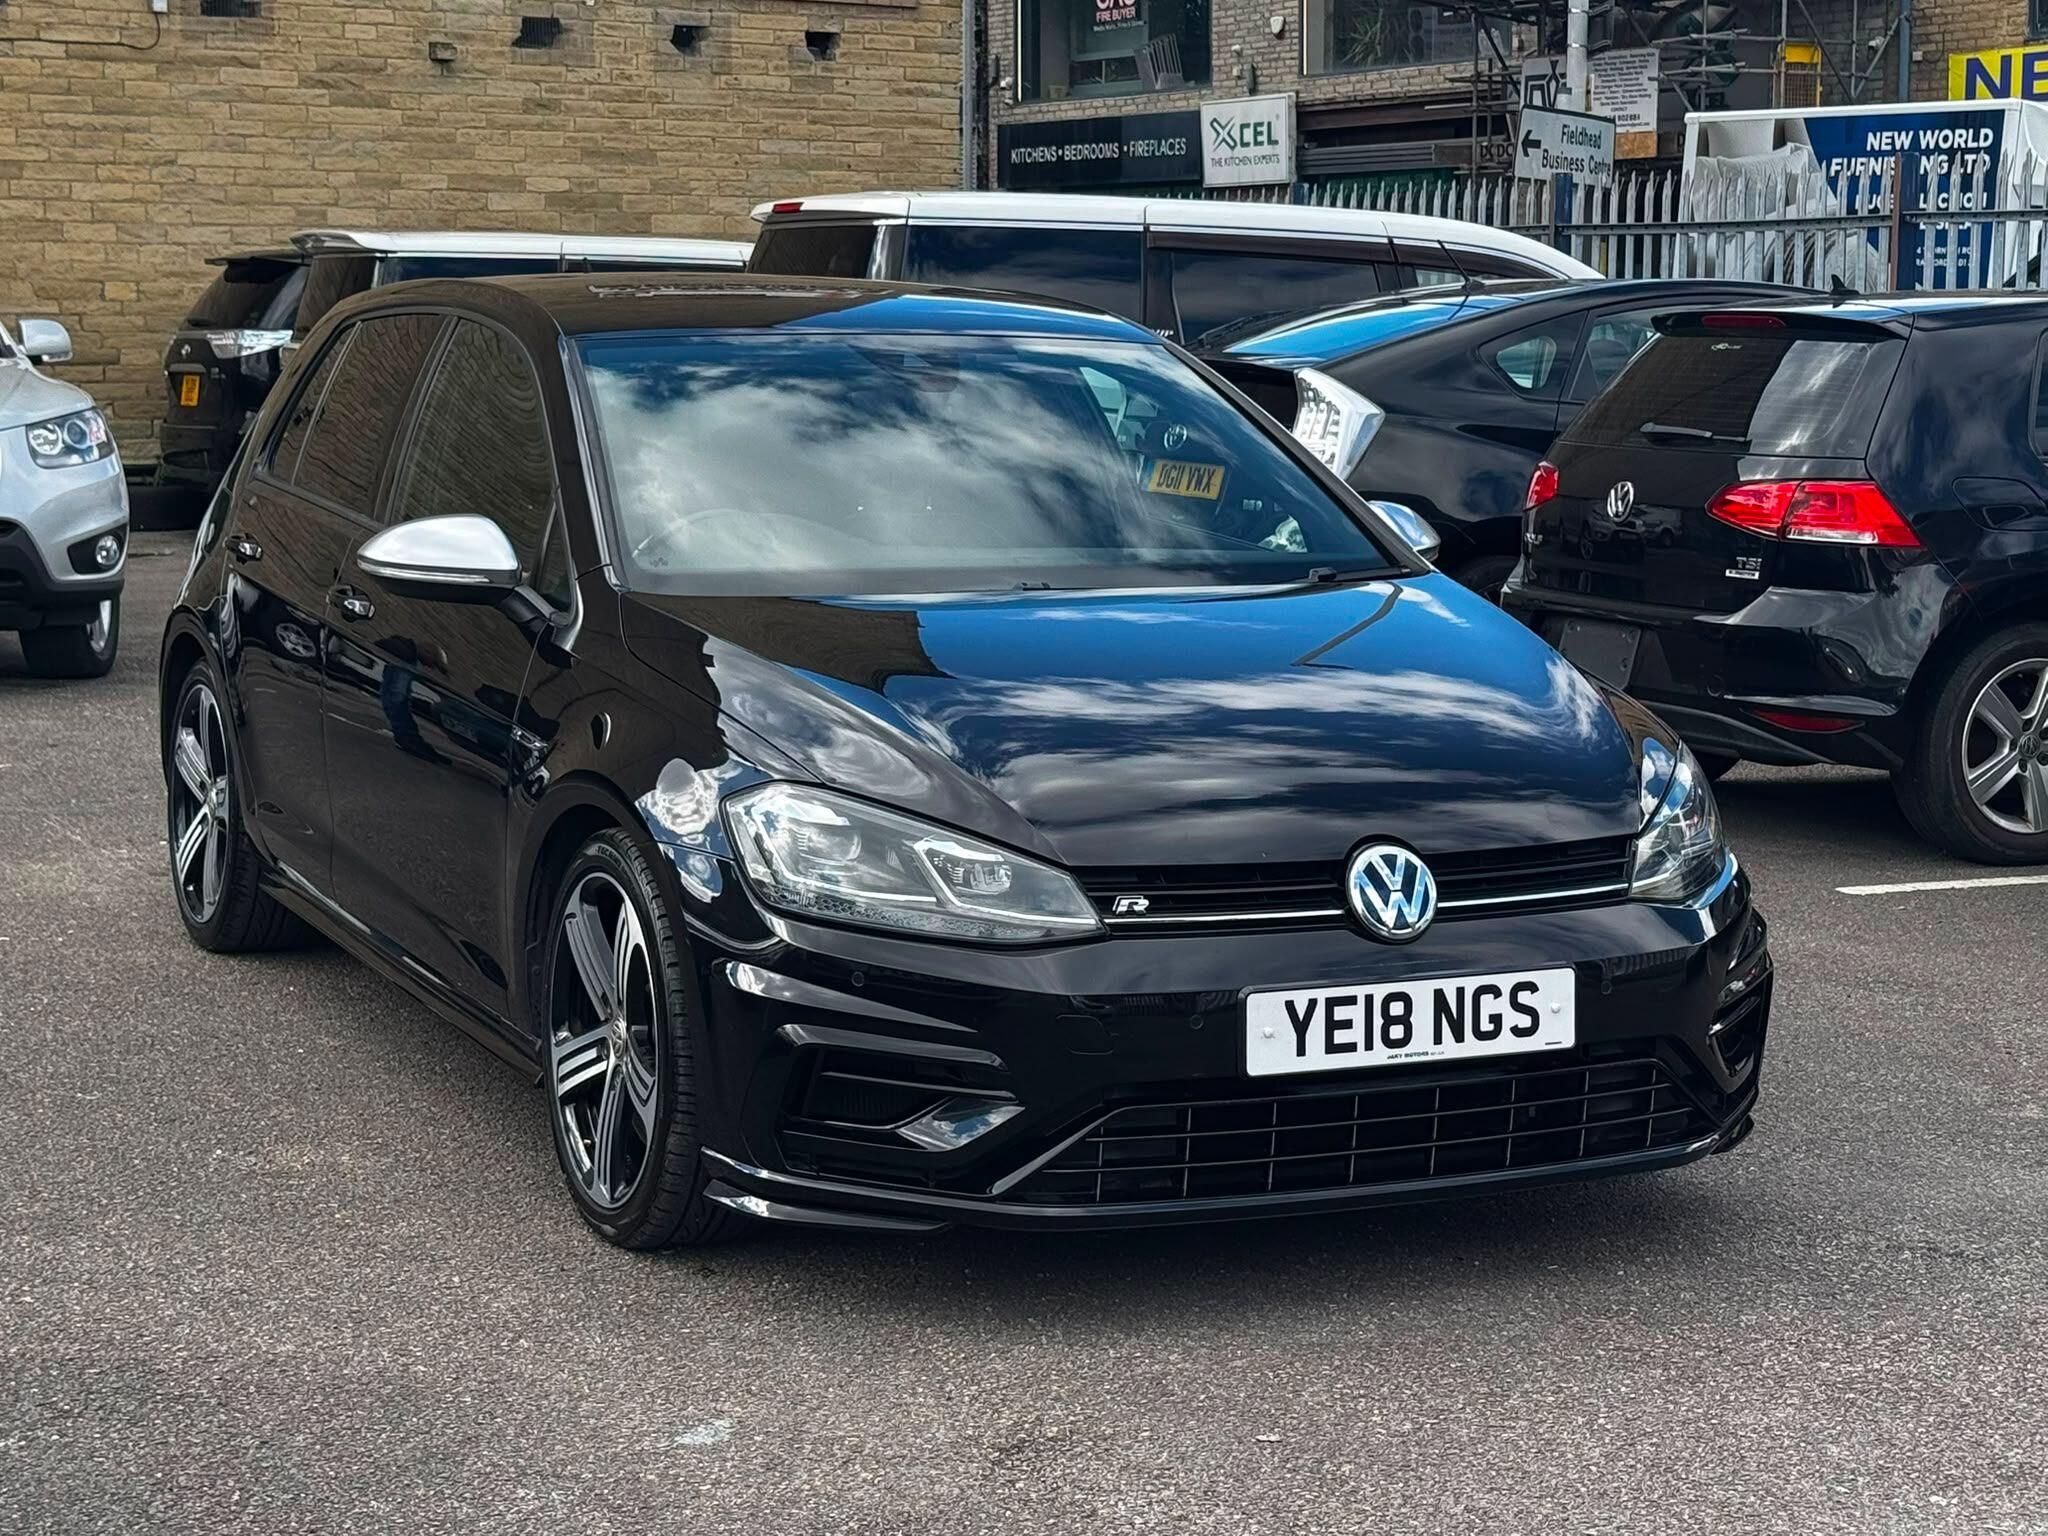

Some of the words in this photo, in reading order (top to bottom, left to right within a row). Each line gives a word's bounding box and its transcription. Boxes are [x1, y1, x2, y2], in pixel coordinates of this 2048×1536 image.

[1095, 10, 1111, 23] FIRE
[1112, 7, 1136, 20] BUYER
[1209, 115, 1280, 152] XCEL
[1560, 123, 1602, 150] Fieldhead
[1866, 130, 1914, 151] NEW
[1919, 128, 1994, 150] WORLD
[1129, 137, 1187, 157] FIREPLACES
[1210, 157, 1224, 168] THE
[1224, 155, 1253, 167] KITCHEN
[1253, 154, 1280, 166] EXPERTS
[1541, 148, 1586, 174] Business
[1588, 154, 1612, 177] Centre
[1285, 991, 1413, 1058] YE18
[1433, 980, 1540, 1046] NGS
